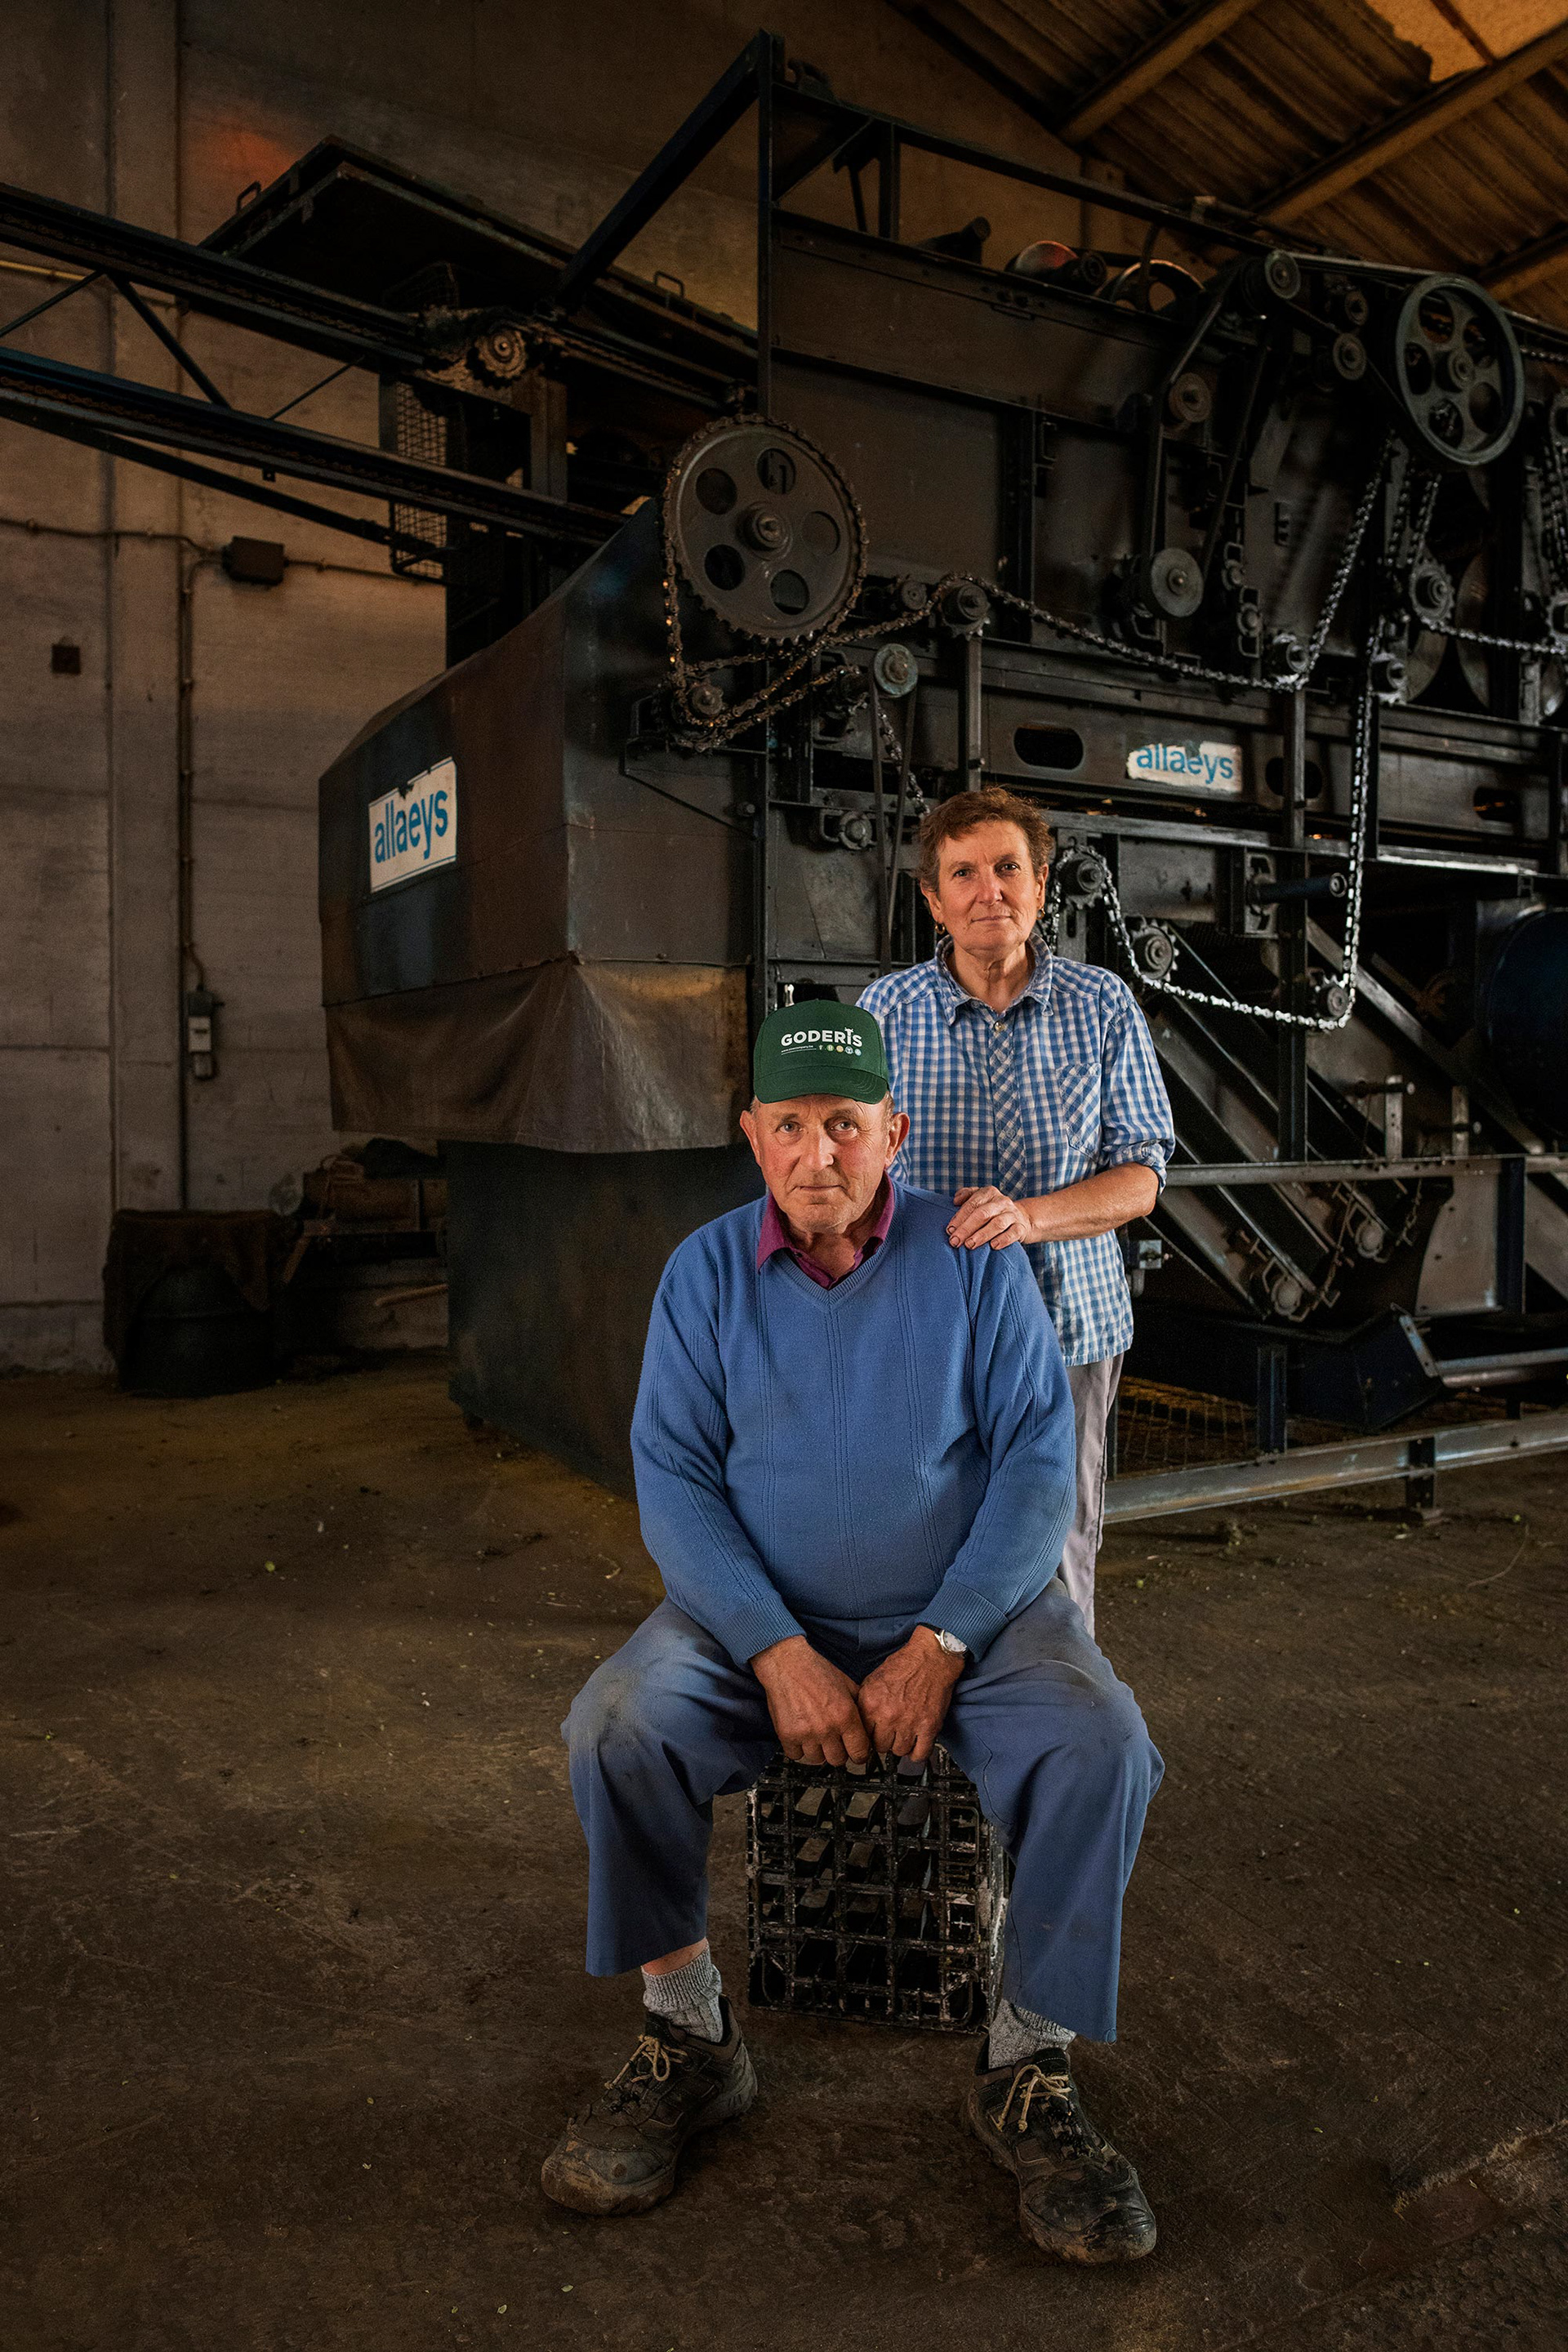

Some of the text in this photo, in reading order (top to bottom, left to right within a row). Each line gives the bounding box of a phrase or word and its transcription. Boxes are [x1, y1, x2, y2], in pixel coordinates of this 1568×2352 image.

[1136, 744, 1233, 784] allaeys
[374, 791, 448, 863] allaeys
[781, 1027, 863, 1048] GODERIS
